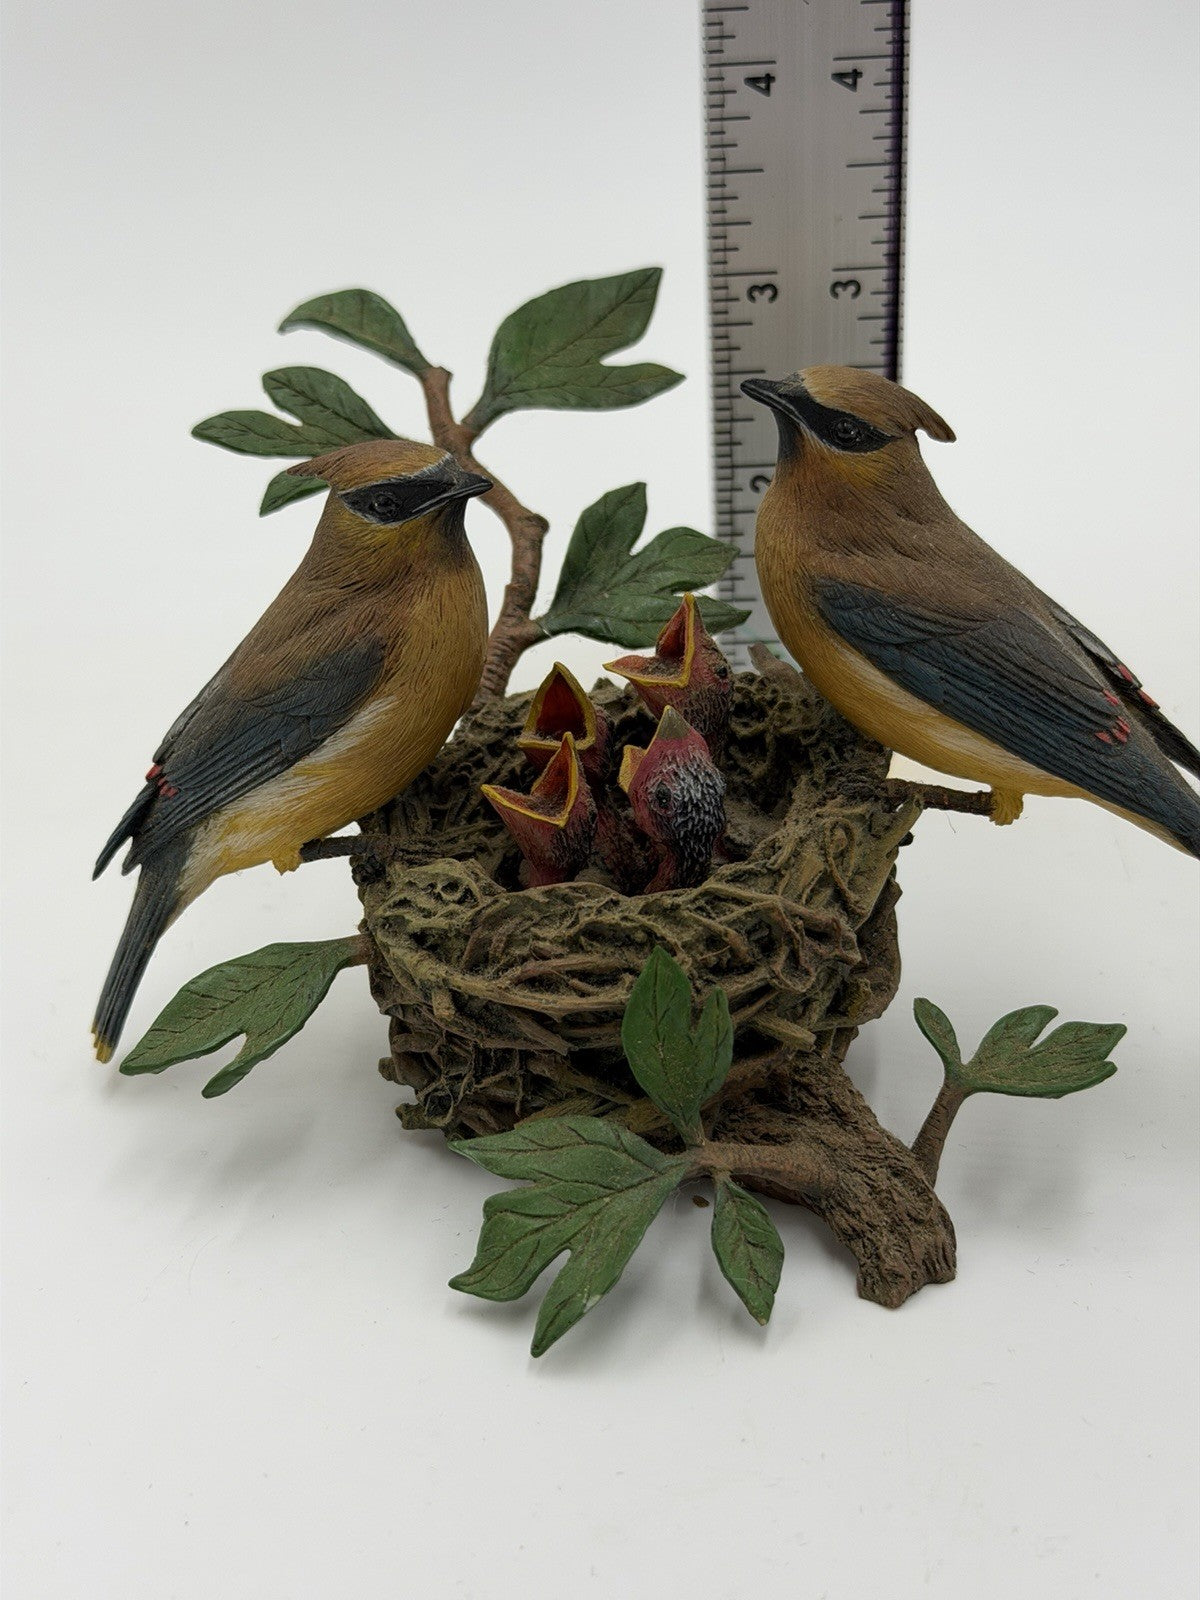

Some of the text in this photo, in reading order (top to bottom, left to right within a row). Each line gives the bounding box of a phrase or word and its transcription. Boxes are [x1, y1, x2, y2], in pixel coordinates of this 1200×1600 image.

[744, 73, 776, 97] 4
[831, 68, 863, 92] 4
[748, 283, 778, 303] 3
[830, 279, 861, 299] 3
